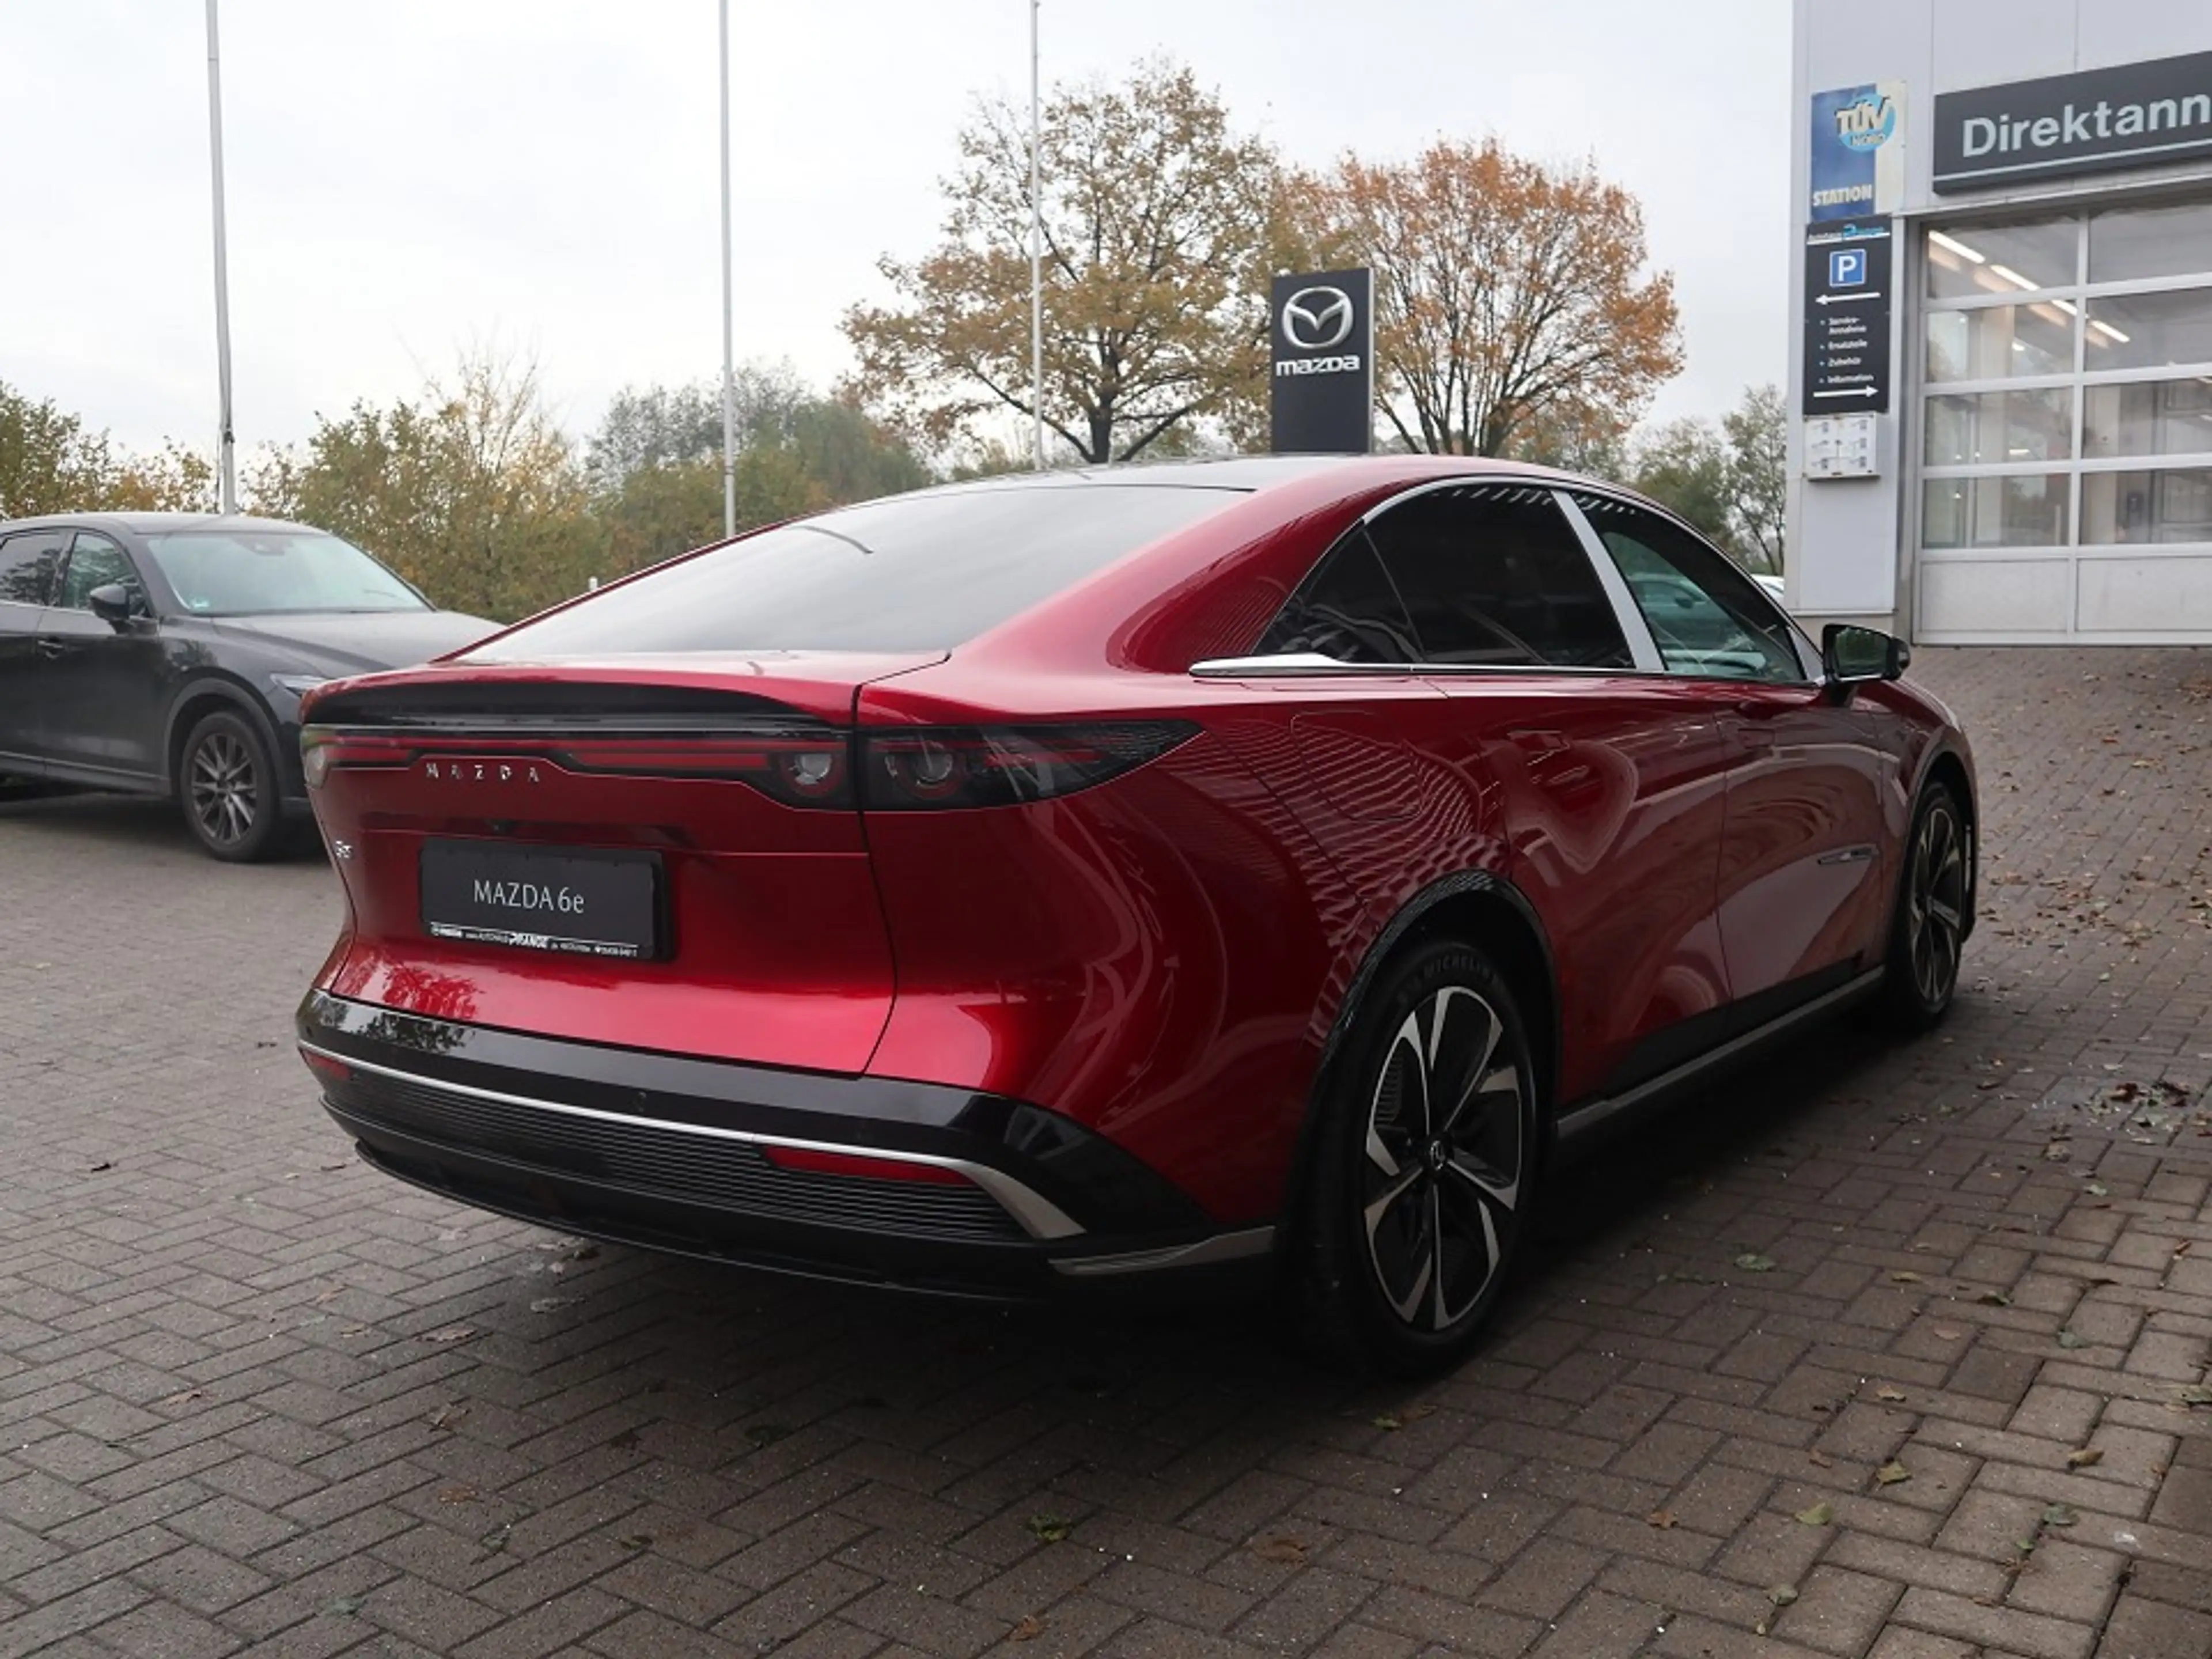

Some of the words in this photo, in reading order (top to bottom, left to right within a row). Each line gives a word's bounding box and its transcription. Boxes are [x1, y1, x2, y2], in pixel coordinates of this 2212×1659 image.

[1834, 95, 1891, 134] TÜV
[1963, 93, 2211, 157] Direktann
[1813, 184, 1872, 207] STATION
[1838, 255, 1857, 282] P
[426, 762, 540, 782] MAZDA
[474, 879, 554, 911] MAZDA
[558, 887, 584, 914] 6e
